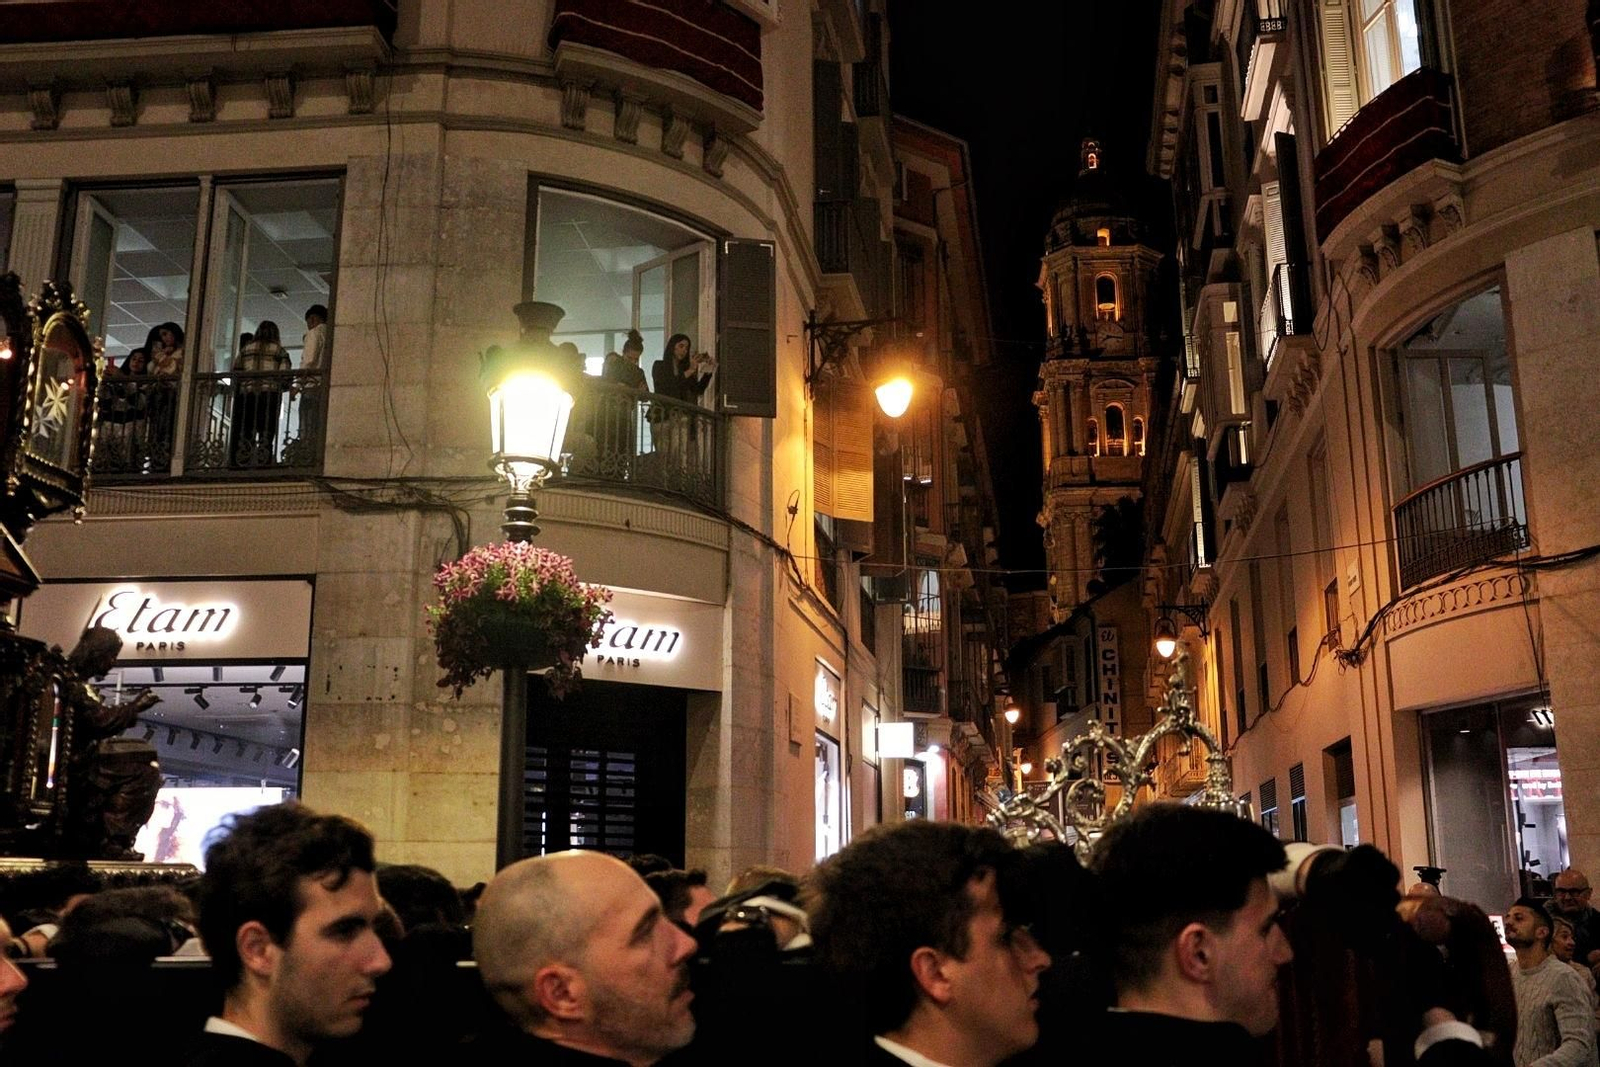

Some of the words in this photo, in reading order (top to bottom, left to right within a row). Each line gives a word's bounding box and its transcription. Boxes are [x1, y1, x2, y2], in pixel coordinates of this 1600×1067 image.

[94, 591, 231, 633] Etam
[592, 610, 680, 653] tam
[136, 641, 186, 651] PARIS
[597, 655, 640, 667] PARIS
[1102, 648, 1120, 764] CHINITS
